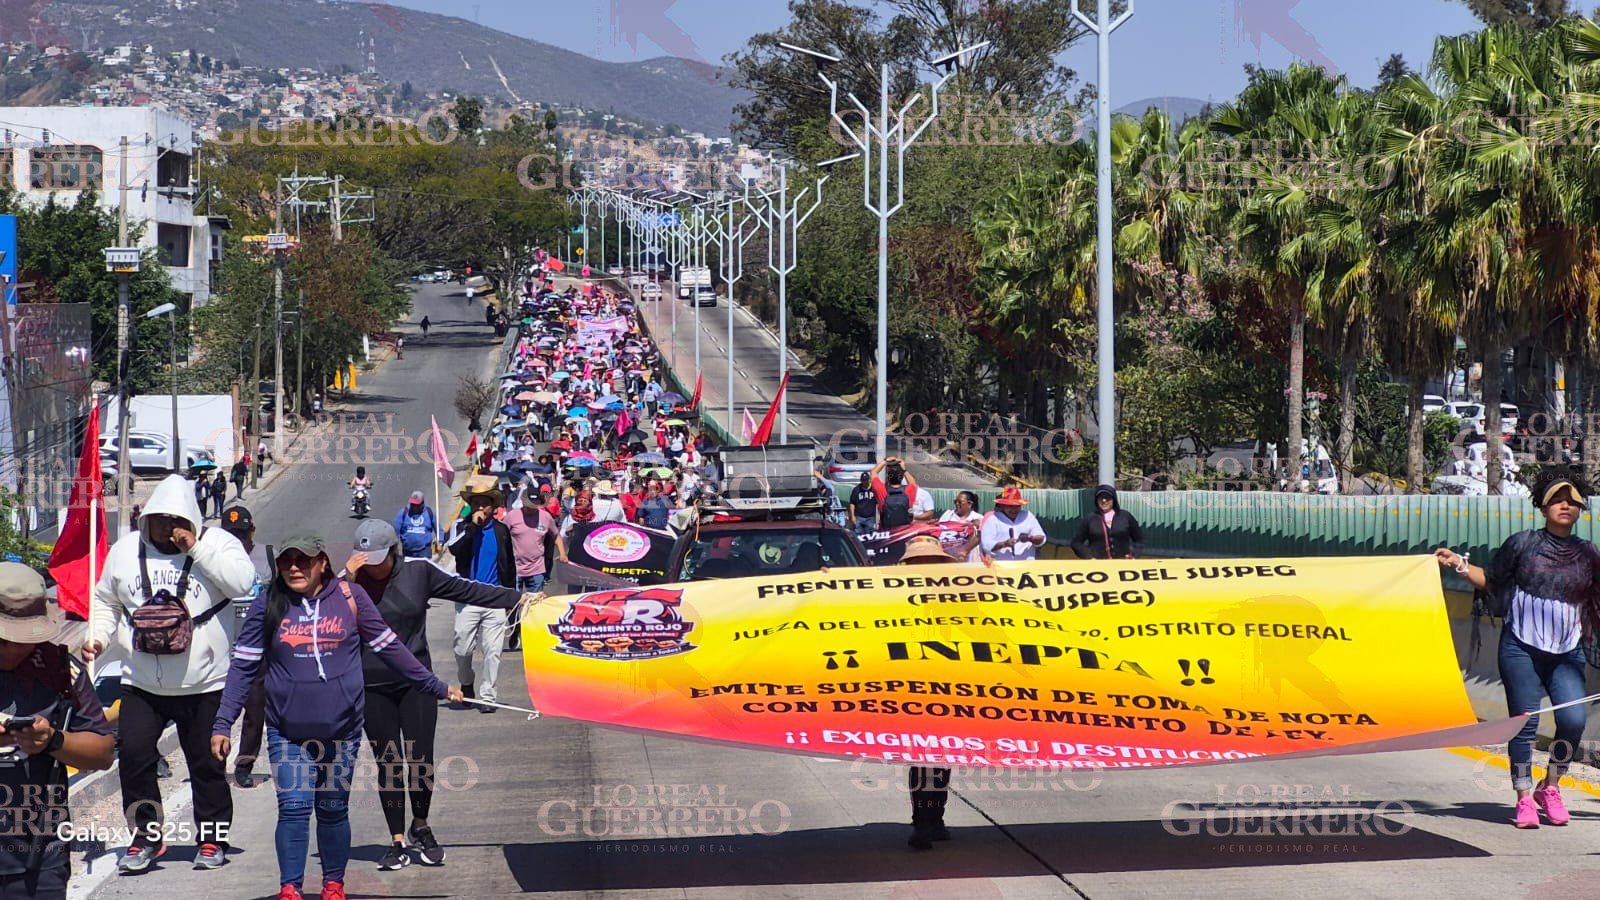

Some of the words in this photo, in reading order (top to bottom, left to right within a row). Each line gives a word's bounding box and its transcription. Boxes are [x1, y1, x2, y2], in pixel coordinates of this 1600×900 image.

[858, 491, 875, 500] GAP
[152, 570, 202, 599] ANGEES
[758, 578, 874, 599] FRENTE
[884, 572, 1109, 591] DEMOCRÁTICO
[1118, 568, 1178, 582] DEL
[1187, 564, 1297, 580] SUSPEG
[558, 623, 642, 633] MOVIMIENTO
[645, 623, 682, 632] ROJO
[732, 620, 811, 642] JUEZA
[819, 621, 867, 632] DEL
[874, 616, 1016, 629] BIENESTAR
[1117, 622, 1236, 639] DISTRITO
[1245, 622, 1353, 642] FEDERAL
[886, 641, 1154, 680] INEPTA
[689, 682, 806, 699] EMITE
[817, 680, 1038, 701] SUSPENSIÓN
[1050, 689, 1098, 706] DE
[1107, 693, 1214, 716] TOMA
[1222, 707, 1270, 723] DE
[1278, 711, 1379, 726] NOTA
[742, 701, 818, 713] CON
[832, 699, 1187, 733] DESCONOCIMIENTO
[1208, 720, 1254, 737] DE
[822, 729, 986, 751] EXIGIMOS
[996, 737, 1040, 754] SU
